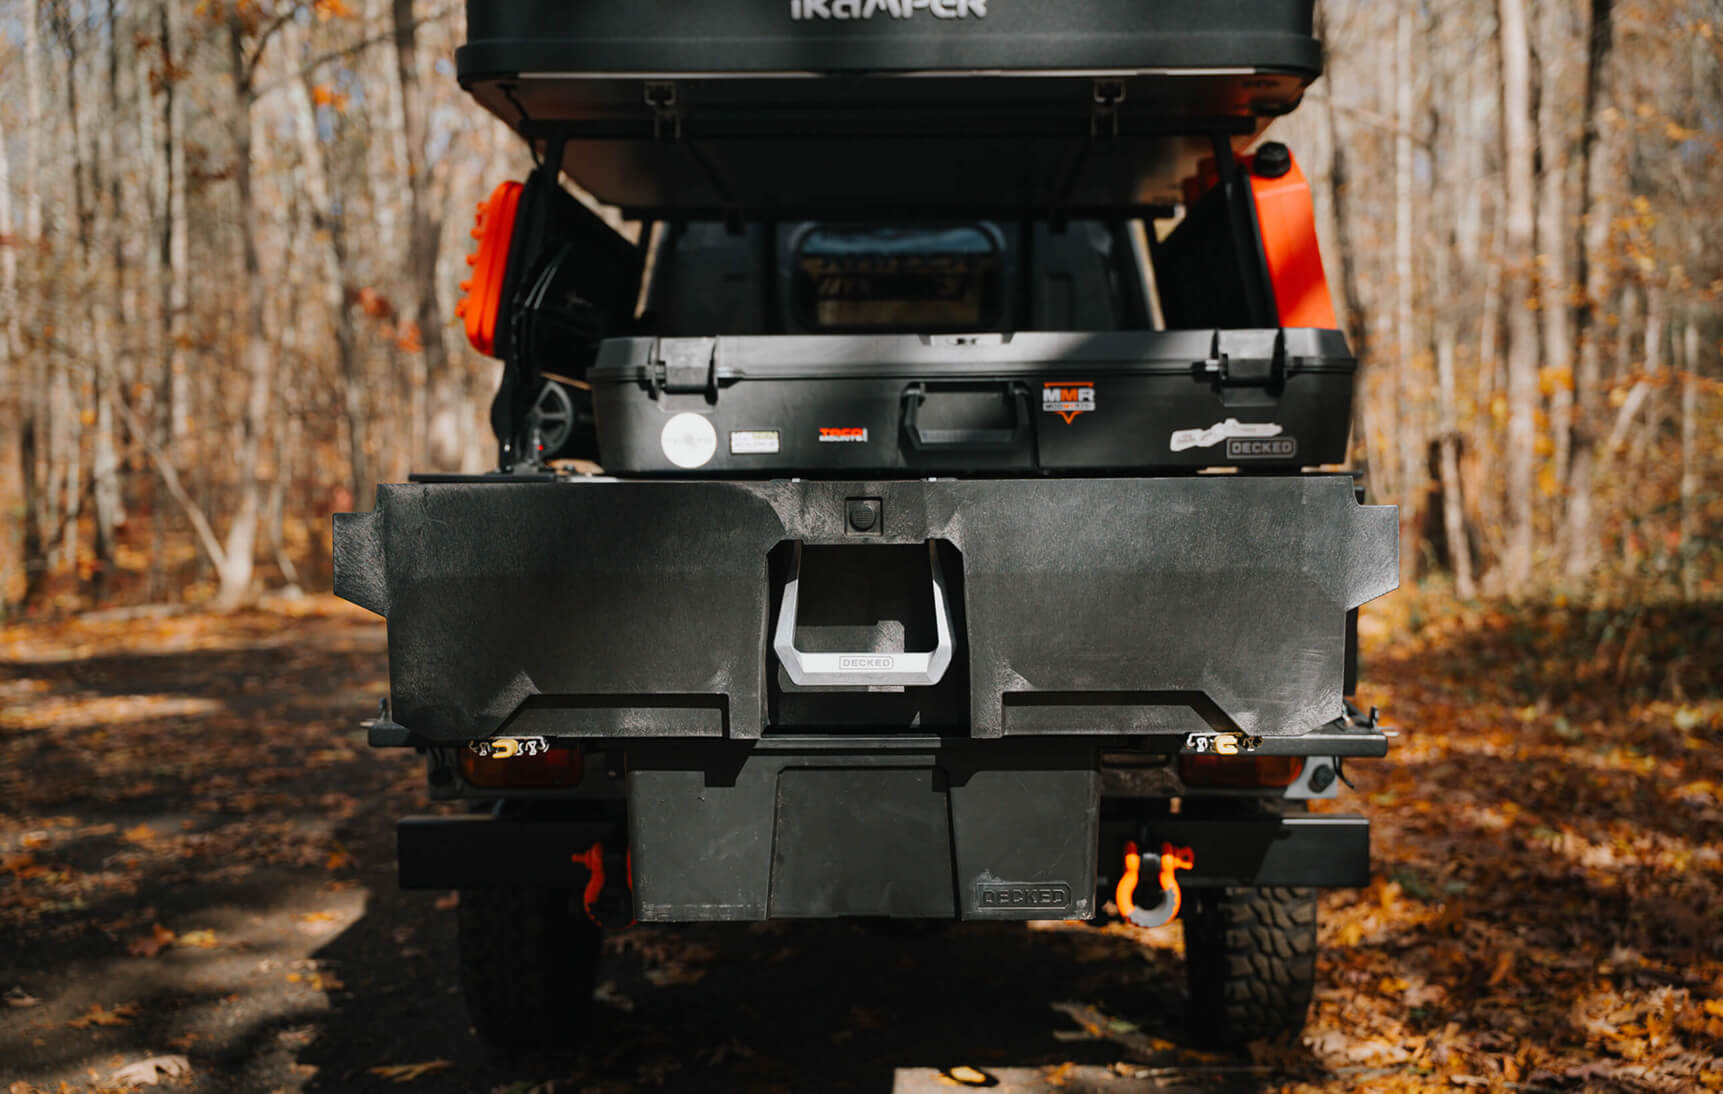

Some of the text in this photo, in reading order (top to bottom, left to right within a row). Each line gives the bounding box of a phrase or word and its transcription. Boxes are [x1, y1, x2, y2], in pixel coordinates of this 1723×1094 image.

[1042, 387, 1095, 402] MMR
[1230, 440, 1294, 455] DECKED
[842, 658, 891, 668] DECKED
[982, 888, 1066, 904] DECKED
